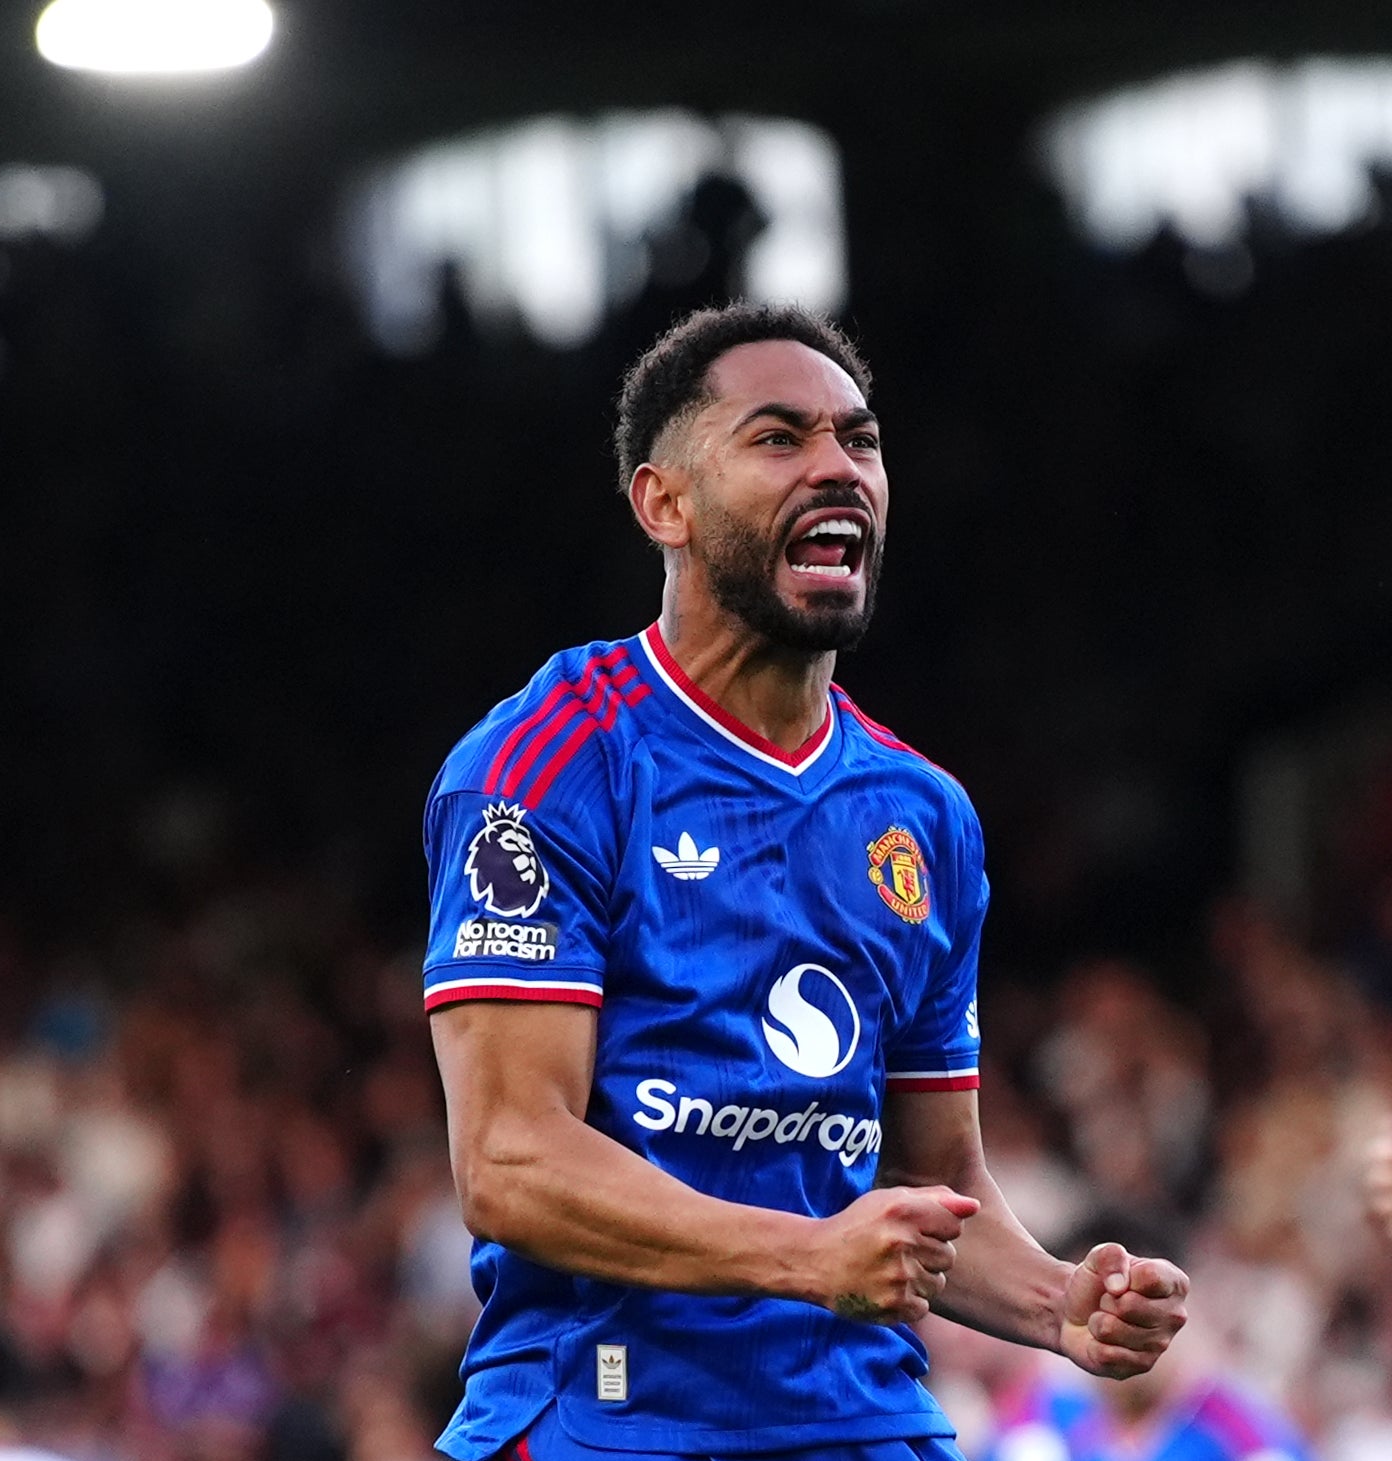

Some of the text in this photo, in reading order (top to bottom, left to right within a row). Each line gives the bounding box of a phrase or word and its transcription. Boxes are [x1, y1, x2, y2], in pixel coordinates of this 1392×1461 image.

[456, 920, 547, 943] No room
[453, 938, 556, 960] for racism
[633, 1079, 883, 1167] Snapdragon
